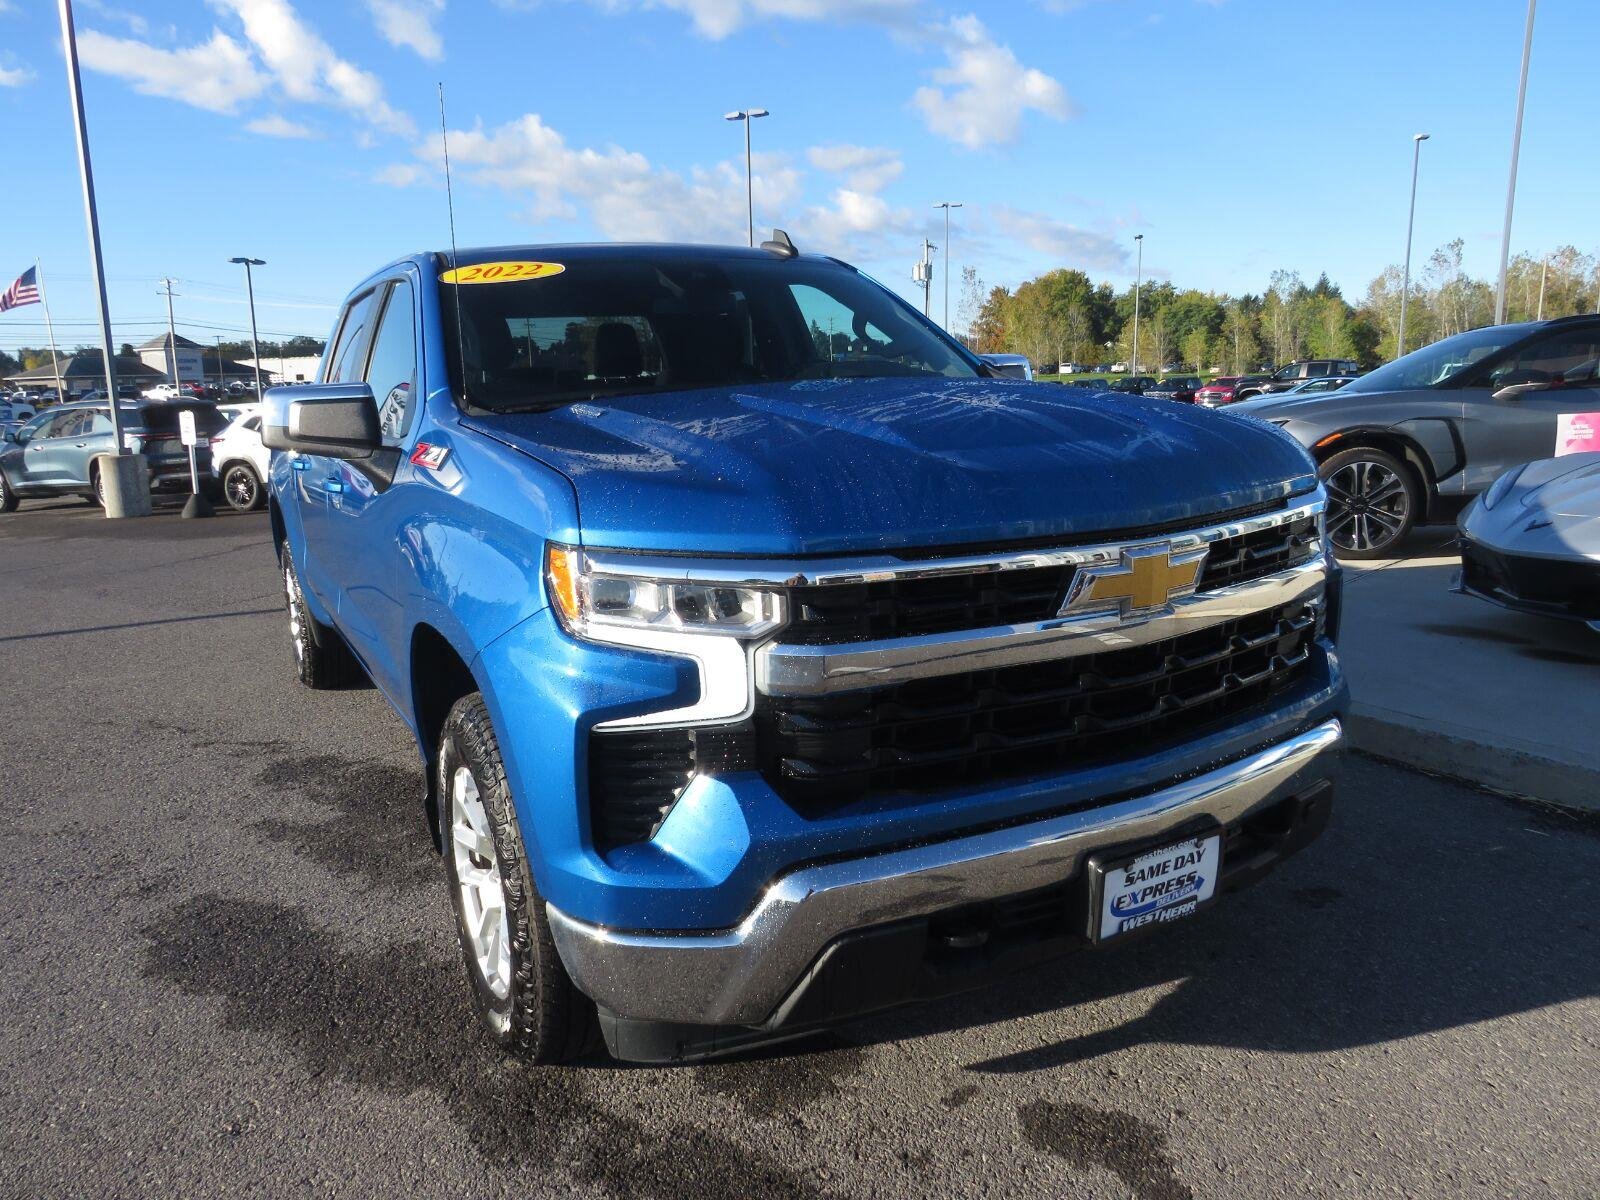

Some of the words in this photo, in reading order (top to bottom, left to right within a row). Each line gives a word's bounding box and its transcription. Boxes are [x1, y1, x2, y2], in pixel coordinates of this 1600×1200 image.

[461, 264, 543, 281] 2022
[1124, 859, 1172, 887] SAME
[1173, 848, 1206, 871] DAY
[1116, 870, 1197, 909] EXPRESS
[1156, 884, 1196, 906] DELIVERY
